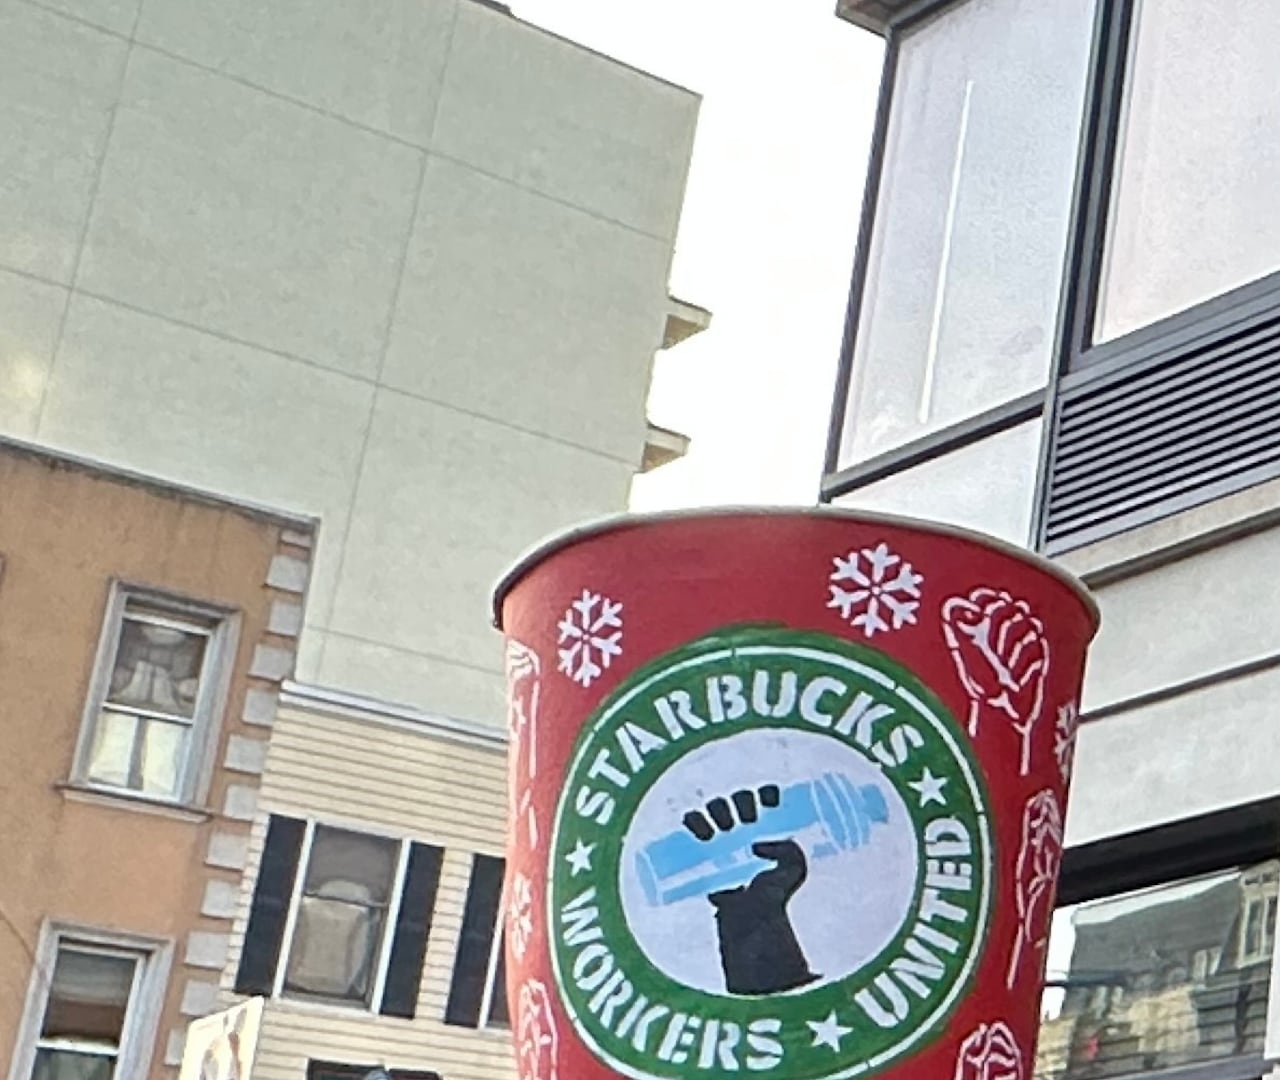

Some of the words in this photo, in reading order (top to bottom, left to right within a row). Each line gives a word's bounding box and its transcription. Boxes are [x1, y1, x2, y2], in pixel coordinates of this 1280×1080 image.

[577, 669, 925, 826] STARBUCKS
[560, 889, 783, 1073] WORKERS
[854, 816, 974, 1029] UNITED
